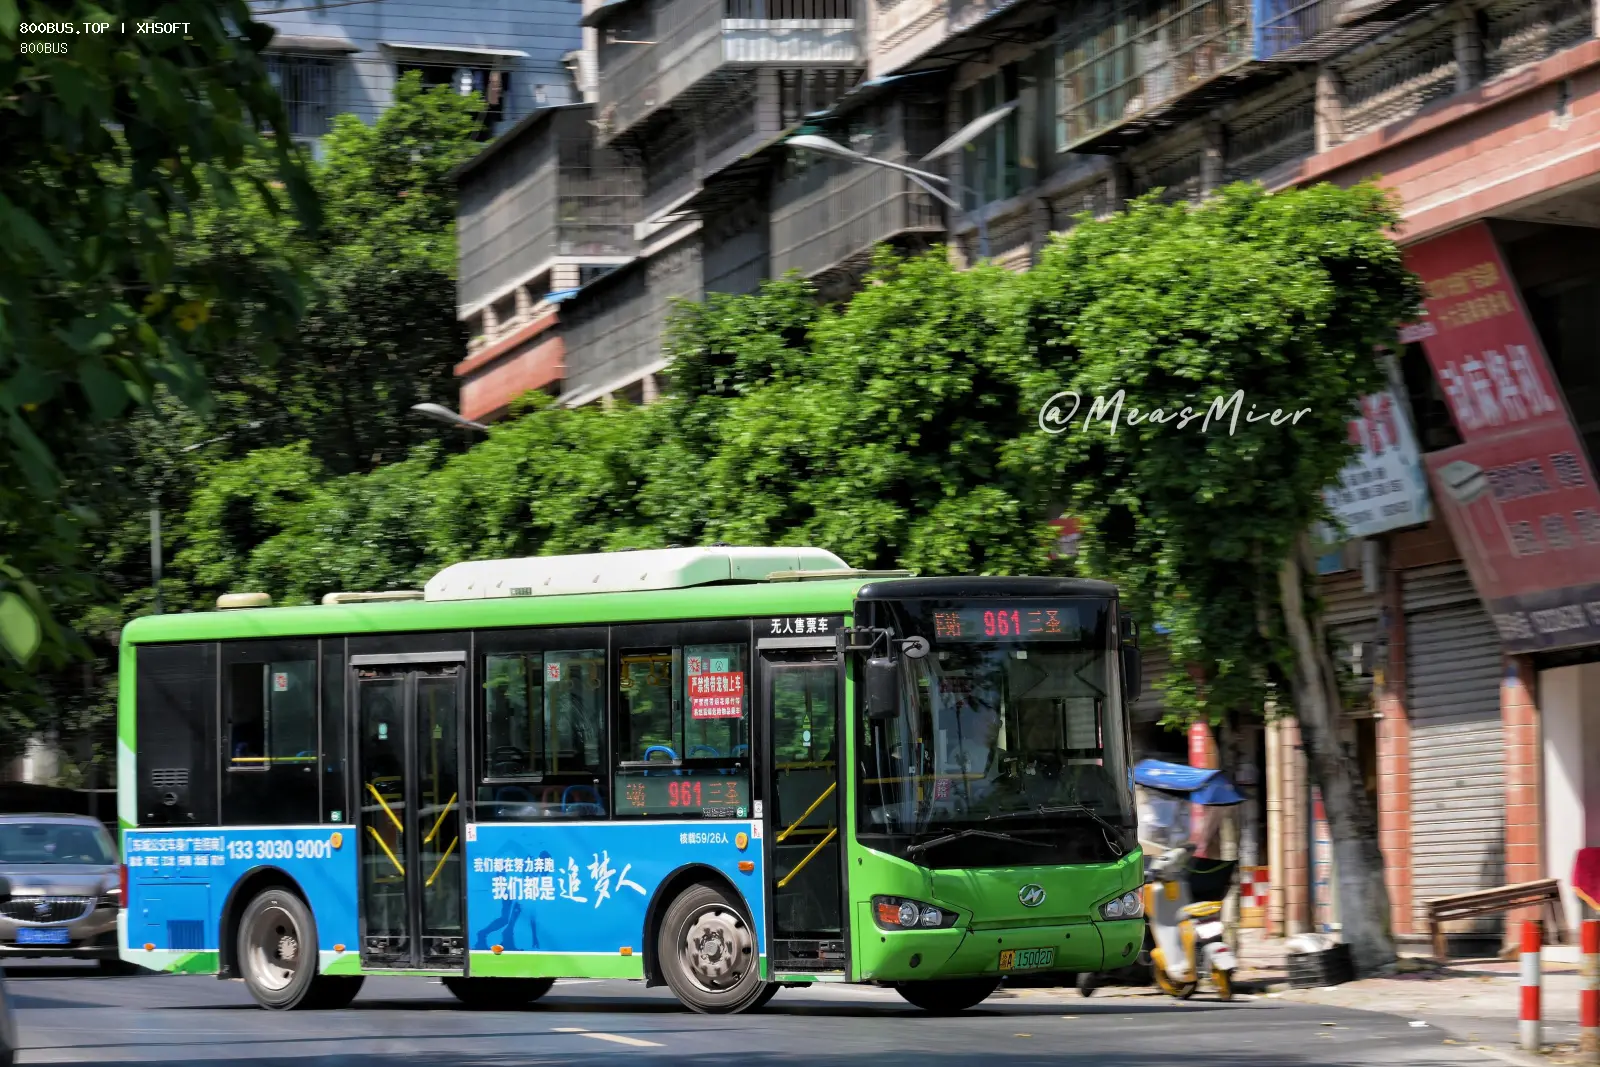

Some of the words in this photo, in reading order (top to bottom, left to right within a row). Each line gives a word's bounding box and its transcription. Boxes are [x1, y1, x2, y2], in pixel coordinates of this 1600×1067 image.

[770, 617, 829, 634] 无人售票车
[983, 609, 1021, 636] 961
[691, 675, 741, 693] 严禁携带宠物上车
[668, 781, 702, 807] 961
[679, 832, 729, 845] 核载59/26人
[227, 839, 253, 860] 133
[255, 839, 293, 859] 3030
[295, 838, 332, 859] 9001
[473, 857, 555, 873] 我们都在努力奔跑
